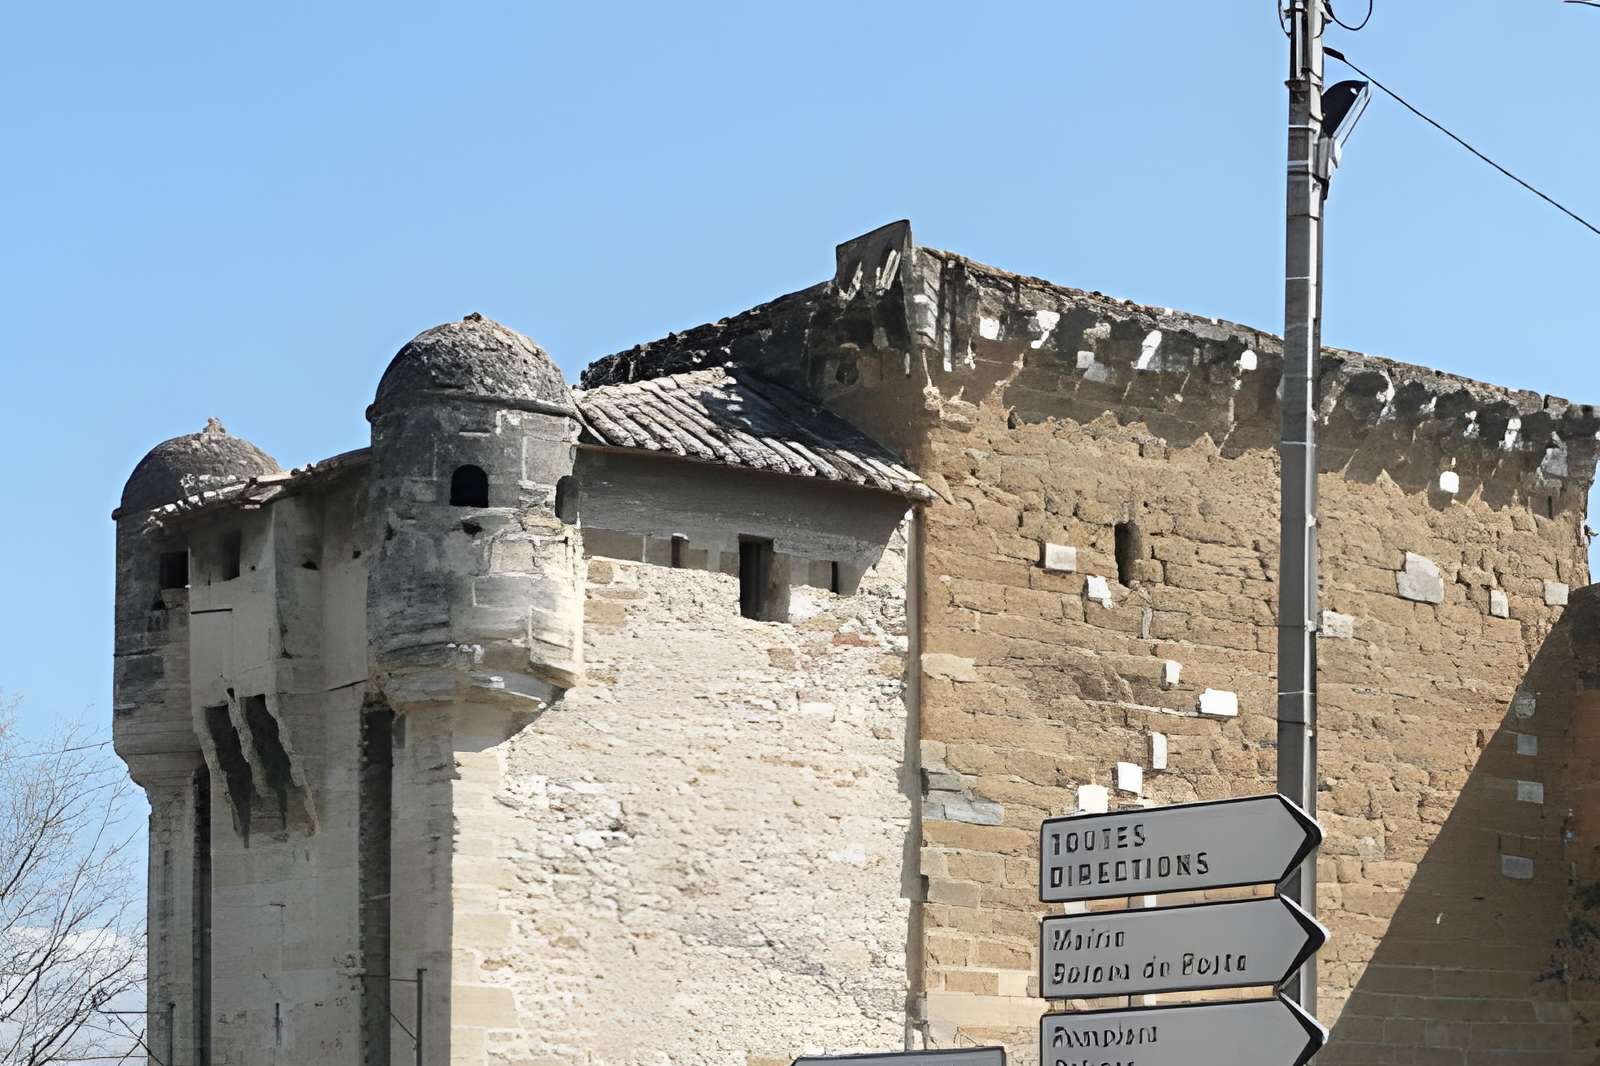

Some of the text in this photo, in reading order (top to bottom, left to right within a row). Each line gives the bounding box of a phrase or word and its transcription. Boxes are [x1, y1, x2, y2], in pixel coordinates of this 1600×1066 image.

[1051, 823, 1146, 856] TOUTES
[1050, 851, 1210, 888] DIRECTIONS
[1142, 955, 1171, 979] de
